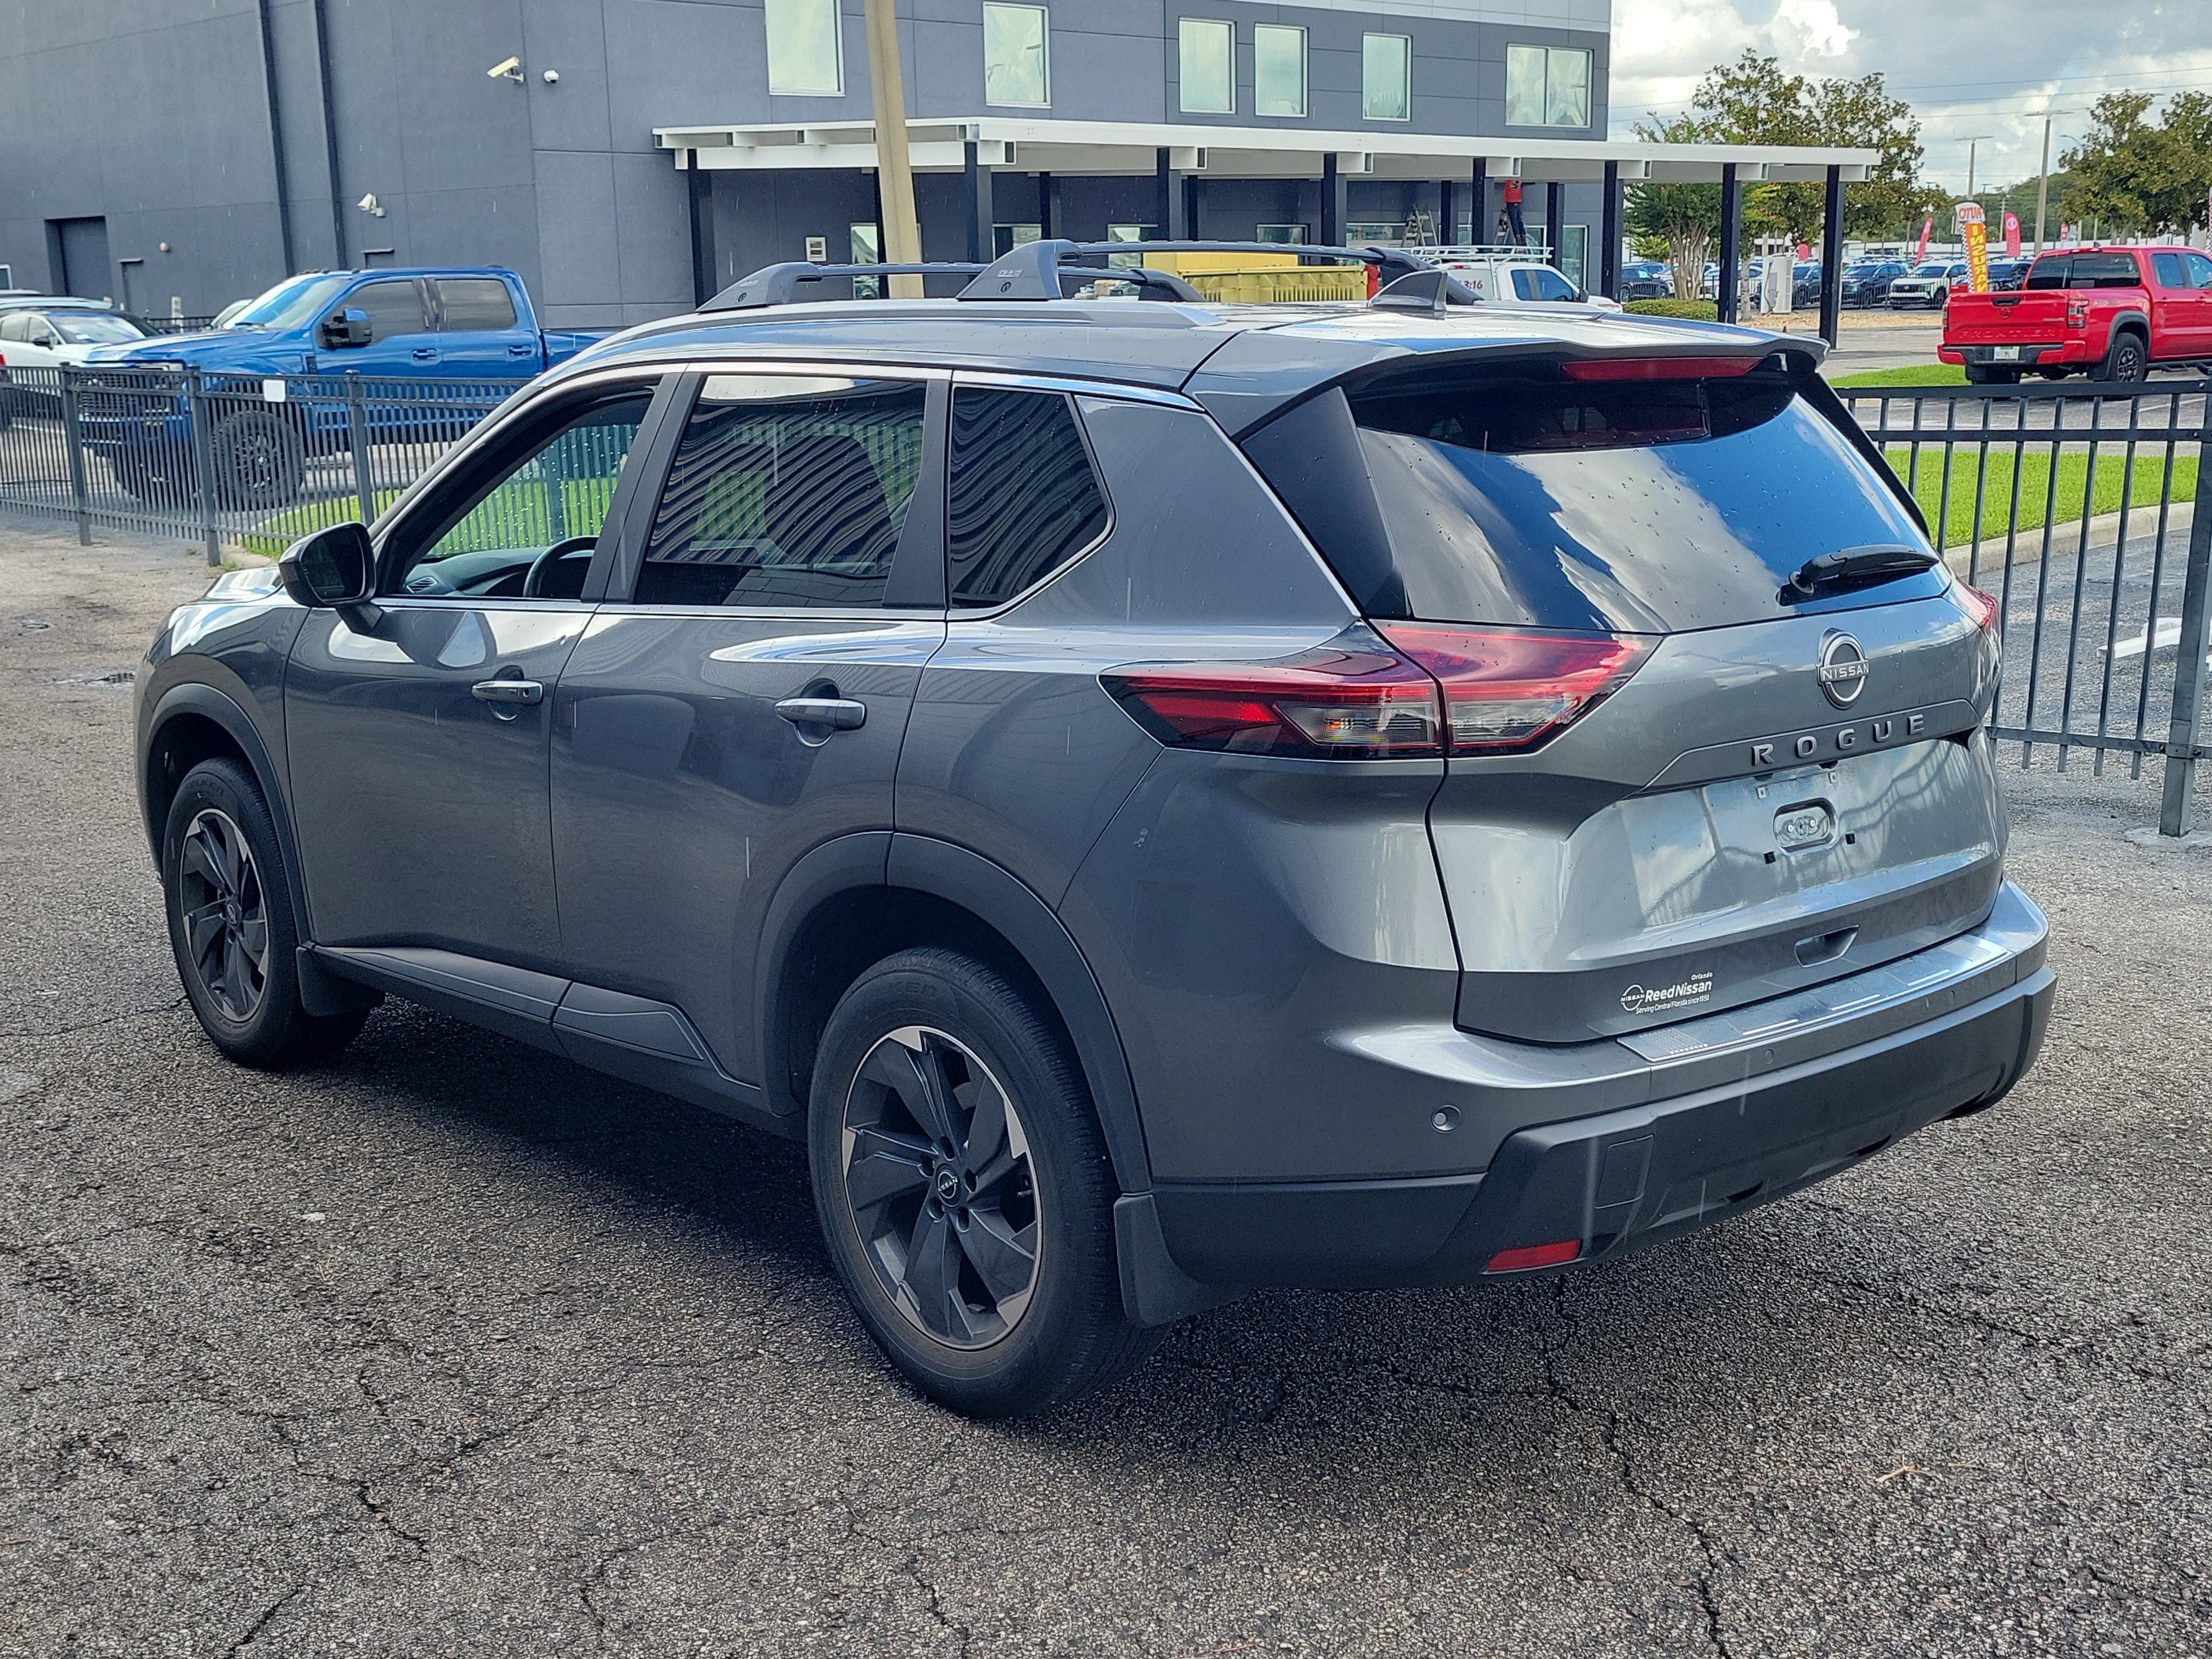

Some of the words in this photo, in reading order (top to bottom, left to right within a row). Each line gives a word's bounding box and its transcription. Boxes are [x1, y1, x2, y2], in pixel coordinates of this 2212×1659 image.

[1822, 662, 1869, 680] NISSAN
[1751, 713, 1925, 766] ROGUE
[1691, 971, 1713, 980] Orlando
[1620, 994, 1645, 1002] NISSAN
